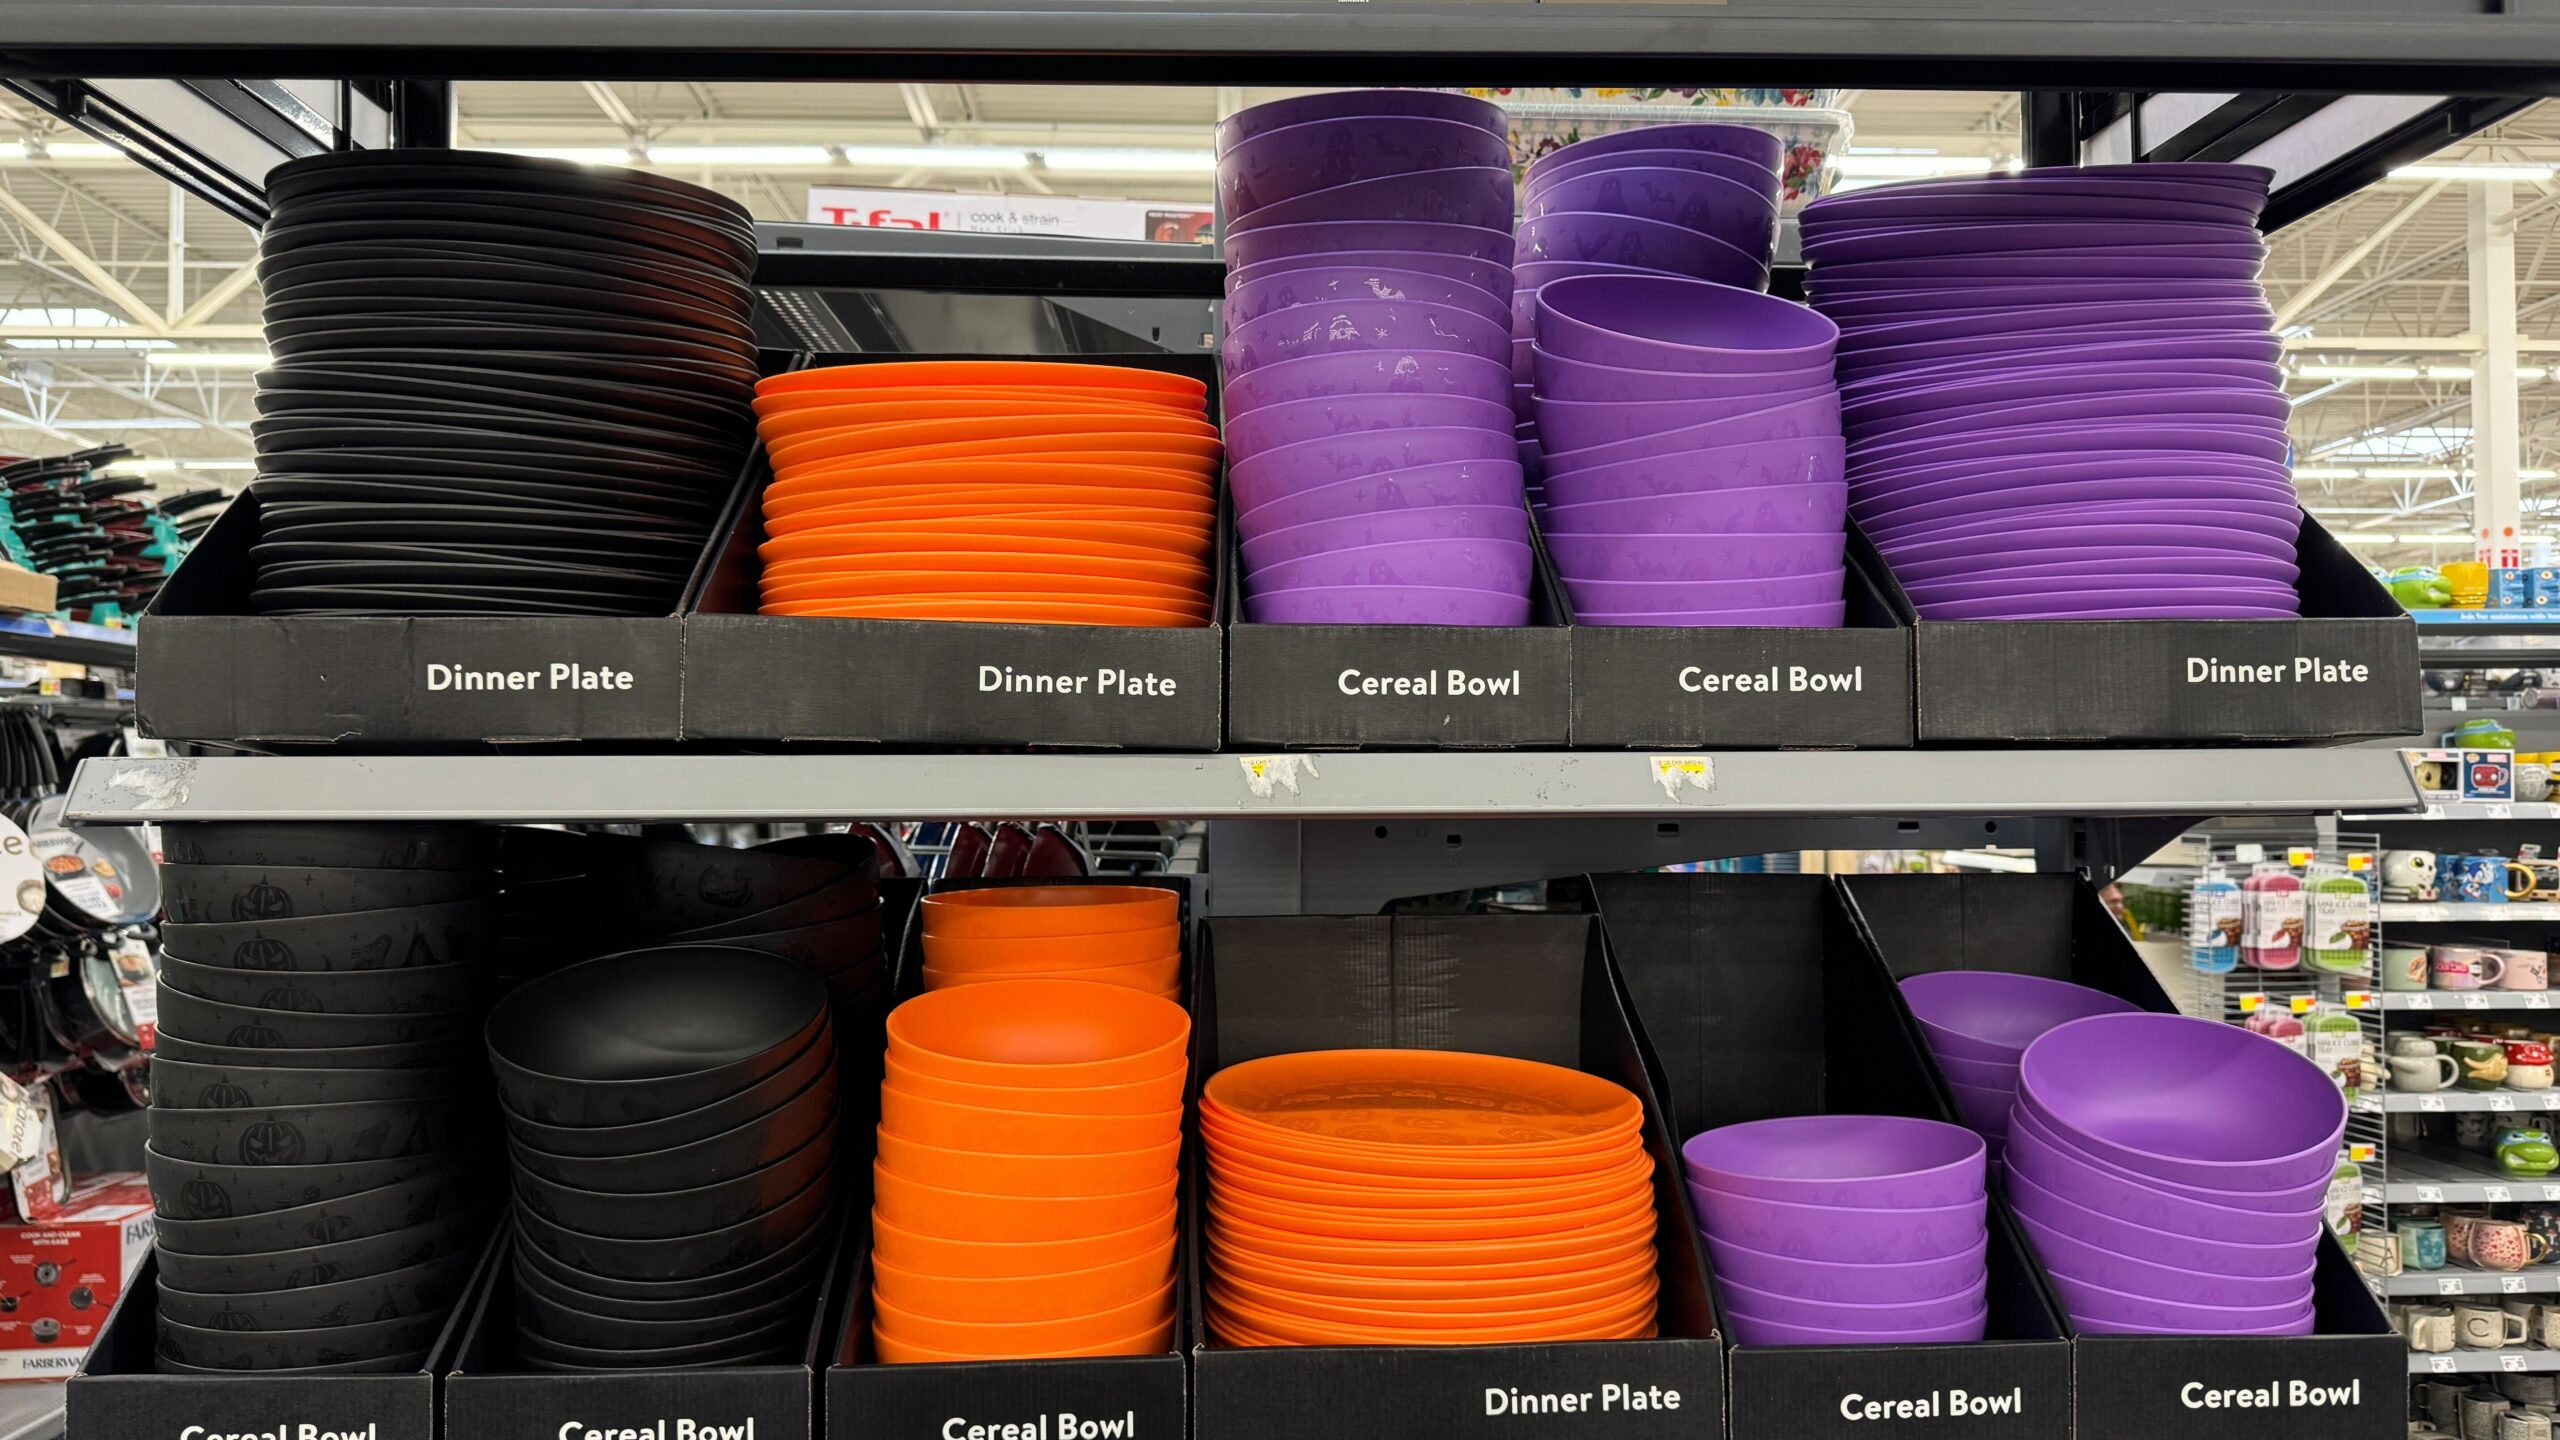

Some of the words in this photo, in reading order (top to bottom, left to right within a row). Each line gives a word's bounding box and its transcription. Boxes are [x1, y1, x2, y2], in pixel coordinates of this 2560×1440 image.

[971, 210, 1004, 225] cook
[1022, 212, 1060, 226] strain
[427, 663, 542, 691] Dinner
[550, 662, 634, 691] Plate
[979, 665, 1089, 694] Dinner
[1097, 668, 1177, 697] Plate
[1337, 668, 1437, 696] Cereal
[1447, 669, 1520, 696] Bowl
[1678, 666, 1779, 693] Cereal
[1789, 665, 1862, 692] Bowl
[2187, 657, 2287, 683] Dinner
[2294, 656, 2369, 683] Plate
[2467, 1316, 2490, 1338] C
[1485, 1387, 1593, 1416] Dinner
[1602, 1383, 1681, 1412] Plate
[1840, 1390, 1940, 1421] Cereal
[1949, 1386, 2022, 1417] Bowl
[2180, 1380, 2280, 1409] Cereal
[2289, 1378, 2360, 1407] Bowl
[558, 1419, 666, 1440] Cereal
[676, 1416, 754, 1440] Bowl
[942, 1414, 1047, 1440] Cereal
[1058, 1410, 1134, 1440] Bowl
